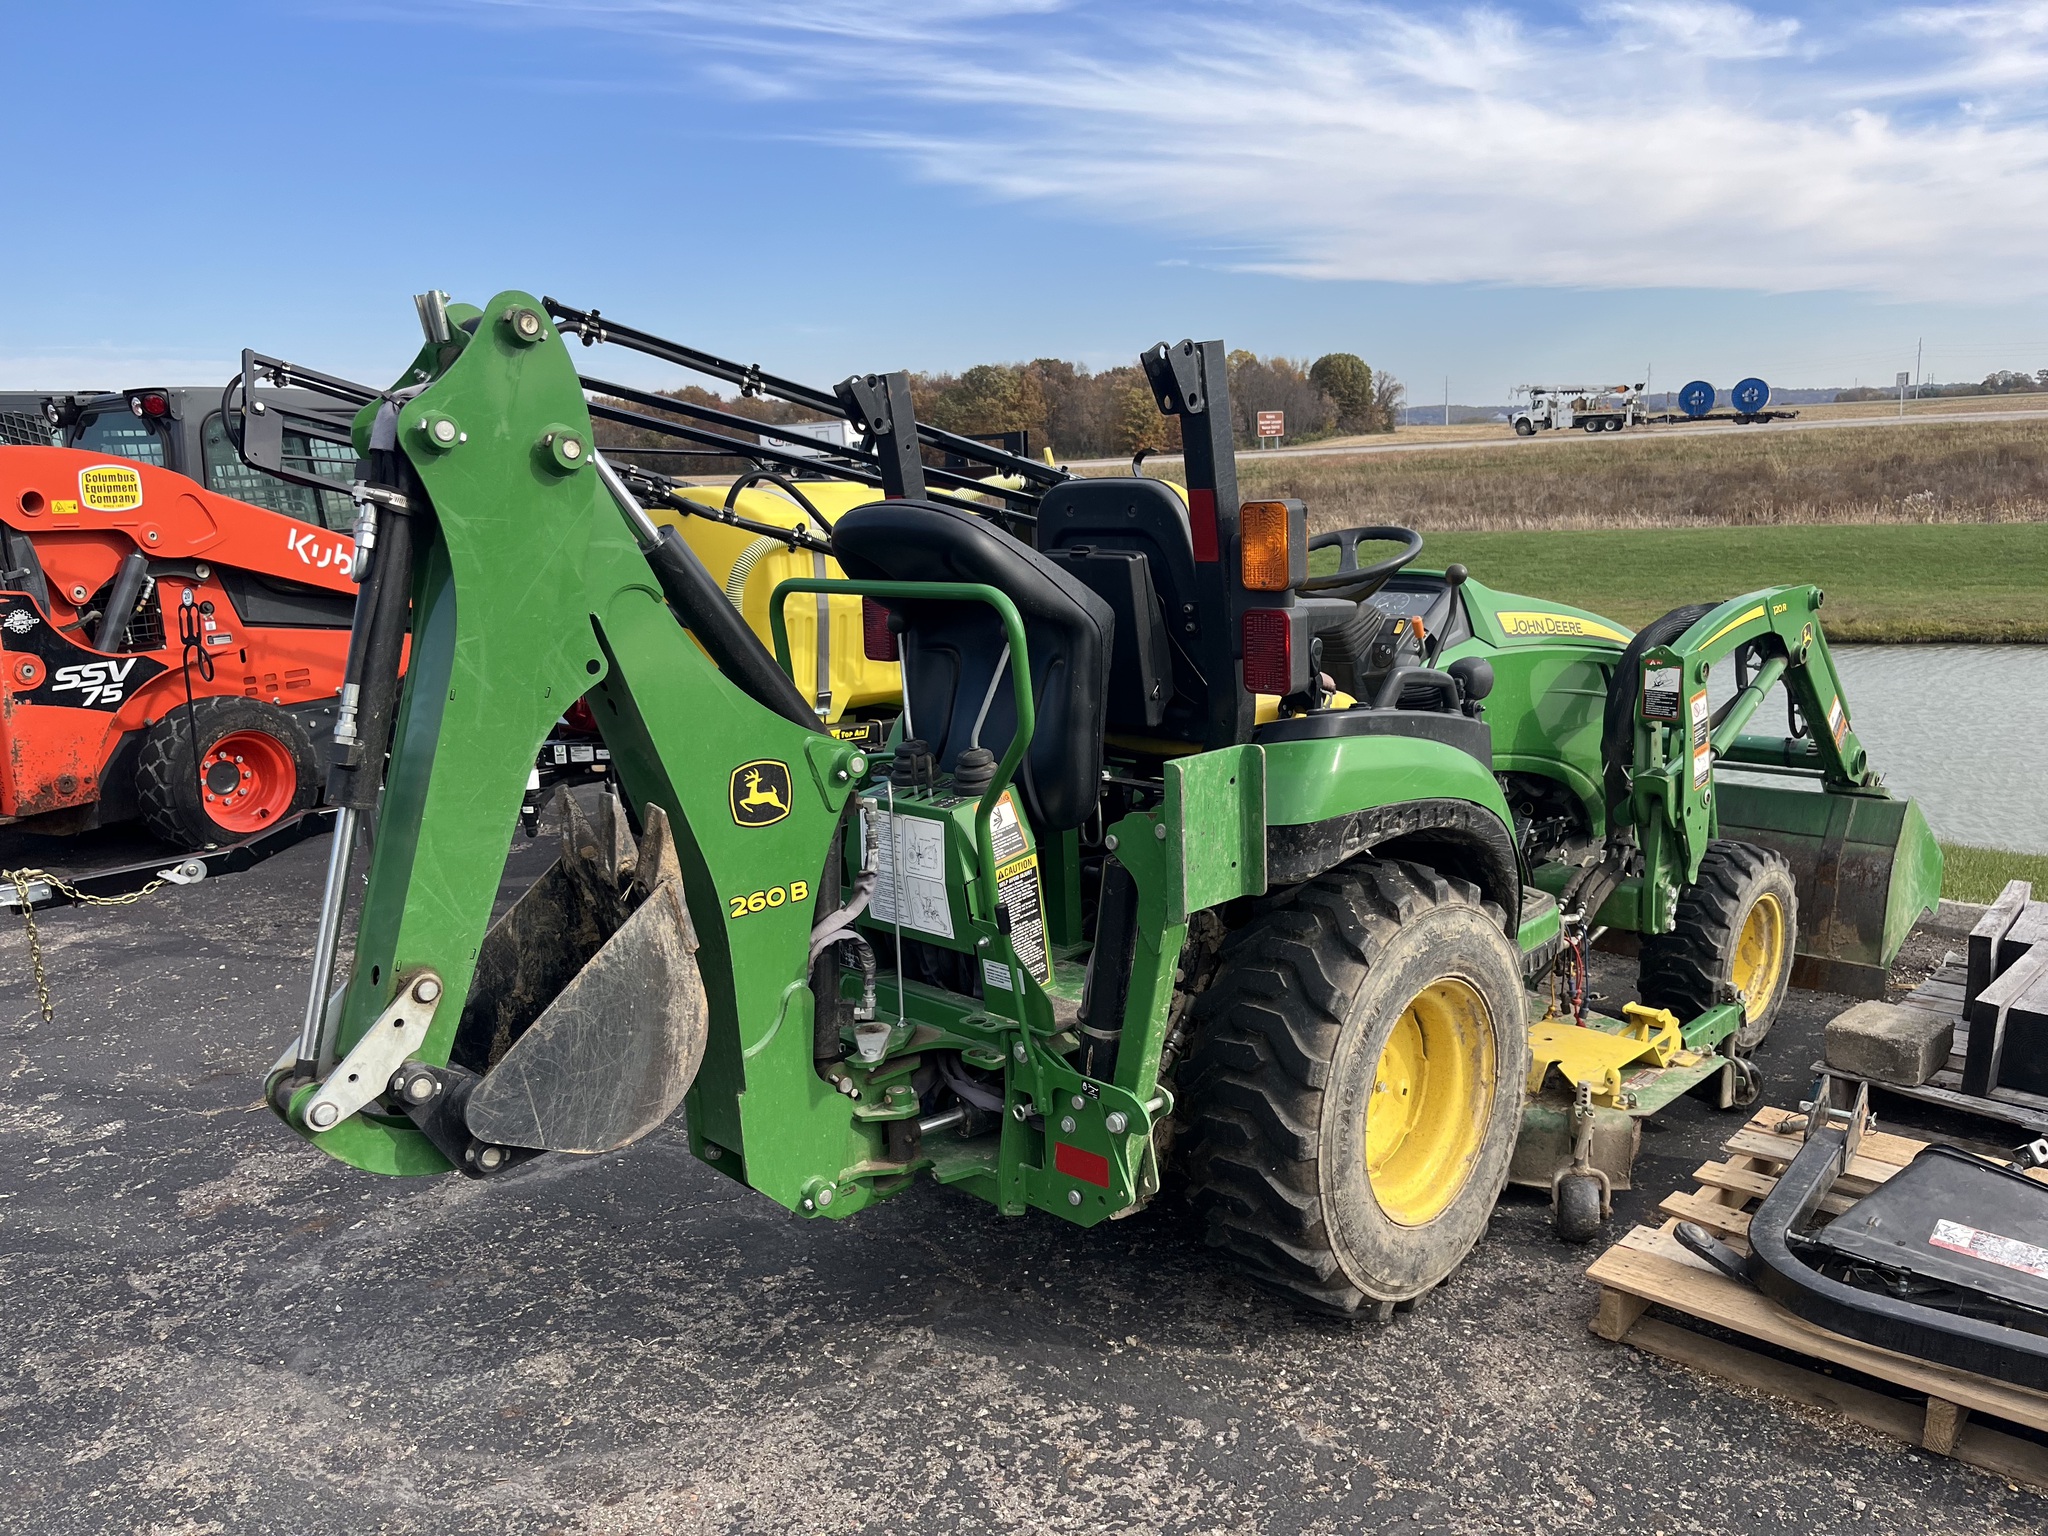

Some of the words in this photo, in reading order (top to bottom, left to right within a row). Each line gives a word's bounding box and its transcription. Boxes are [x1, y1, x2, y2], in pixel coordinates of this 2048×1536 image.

[85, 473, 136, 483] Columbus
[85, 483, 139, 494] Equipment
[89, 494, 137, 504] Company
[287, 527, 353, 575] Kub
[1512, 617, 1545, 633] JOHN
[1545, 617, 1584, 634] DEERE
[52, 657, 138, 692] SSV
[81, 682, 124, 707] 75
[840, 730, 853, 739] TOP
[854, 729, 866, 737] AIR
[1003, 857, 1033, 877] CAUTION
[729, 885, 787, 919] 260
[790, 879, 809, 903] B
